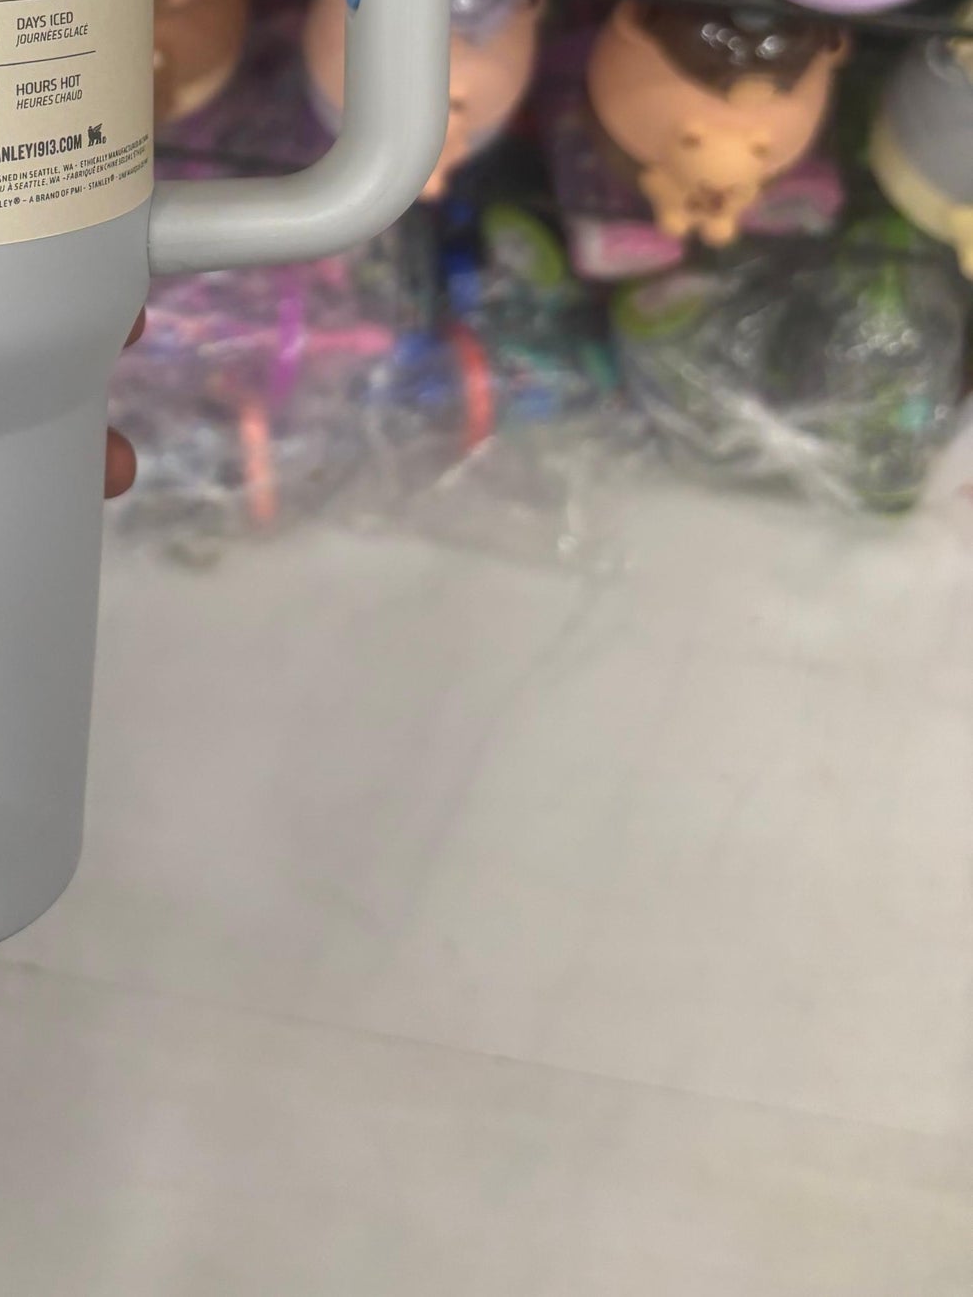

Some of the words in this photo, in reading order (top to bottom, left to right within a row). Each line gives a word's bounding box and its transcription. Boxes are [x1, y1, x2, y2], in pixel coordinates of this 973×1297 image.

[16, 15, 47, 31] DAYS
[50, 11, 74, 26] ICED
[15, 28, 63, 48] JOURNÉES
[63, 23, 89, 39] GLACÉ
[16, 78, 57, 96] HOURS
[60, 74, 81, 89] HOT
[16, 94, 54, 110] HEURES
[54, 89, 83, 104] CHAUD
[19, 172, 28, 180] IN
[63, 163, 74, 173] WA
[49, 175, 60, 184] WA
[29, 196, 34, 204] A
[35, 191, 60, 202] BRAND
[61, 188, 69, 197] OF
